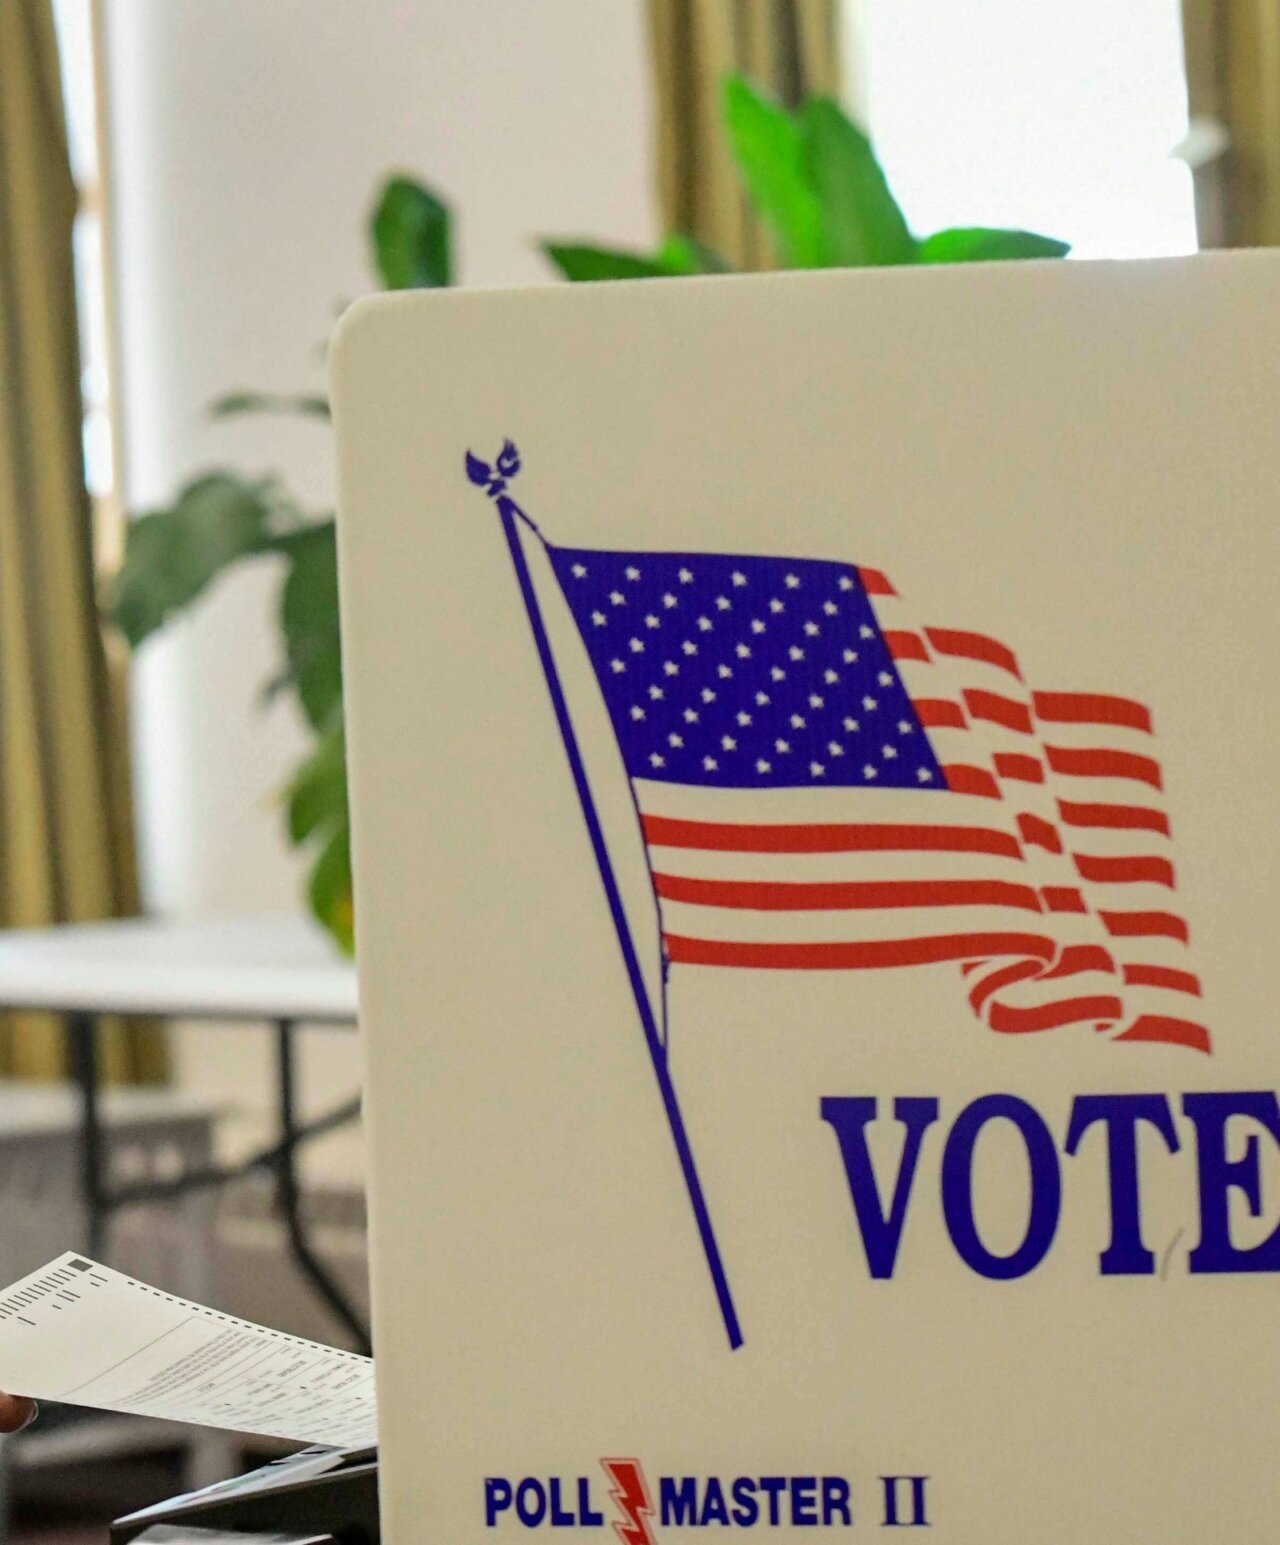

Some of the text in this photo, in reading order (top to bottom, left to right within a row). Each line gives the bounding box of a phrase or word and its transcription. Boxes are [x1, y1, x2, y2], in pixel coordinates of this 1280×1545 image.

[820, 1090, 1280, 1280] VOTE
[484, 1475, 932, 1528] POLL MASTER II
